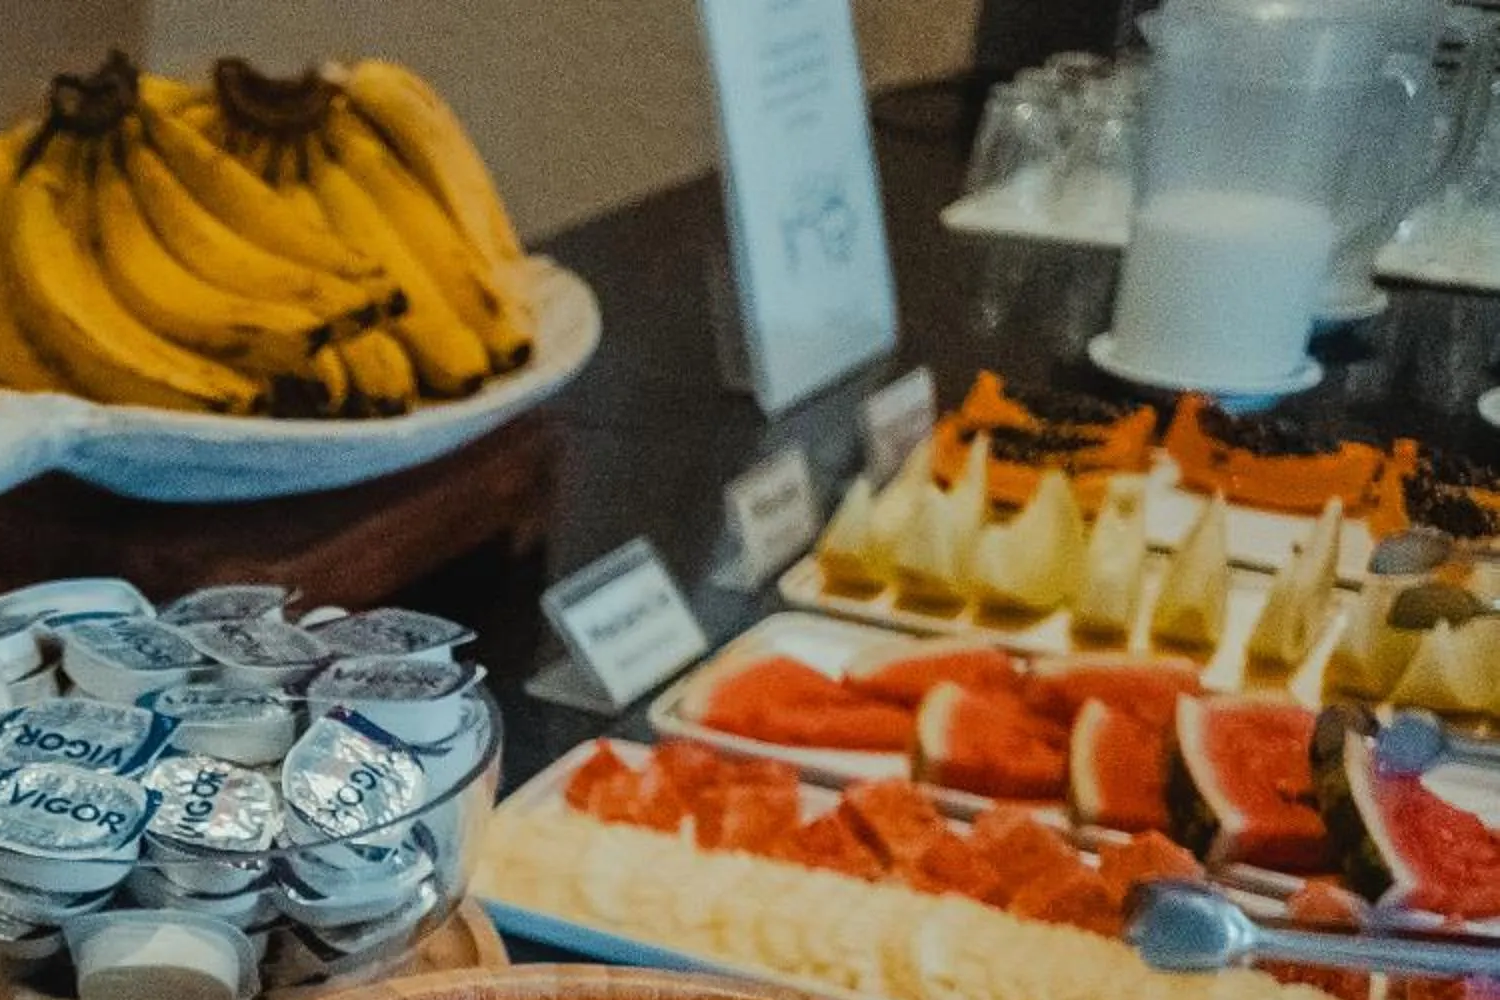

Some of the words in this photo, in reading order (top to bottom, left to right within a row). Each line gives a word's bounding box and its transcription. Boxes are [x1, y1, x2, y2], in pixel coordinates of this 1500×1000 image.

[13, 723, 124, 767] VIGOR
[7, 782, 127, 834] VIGOR
[172, 769, 228, 839] VIGOR
[326, 757, 390, 818] IGOR
